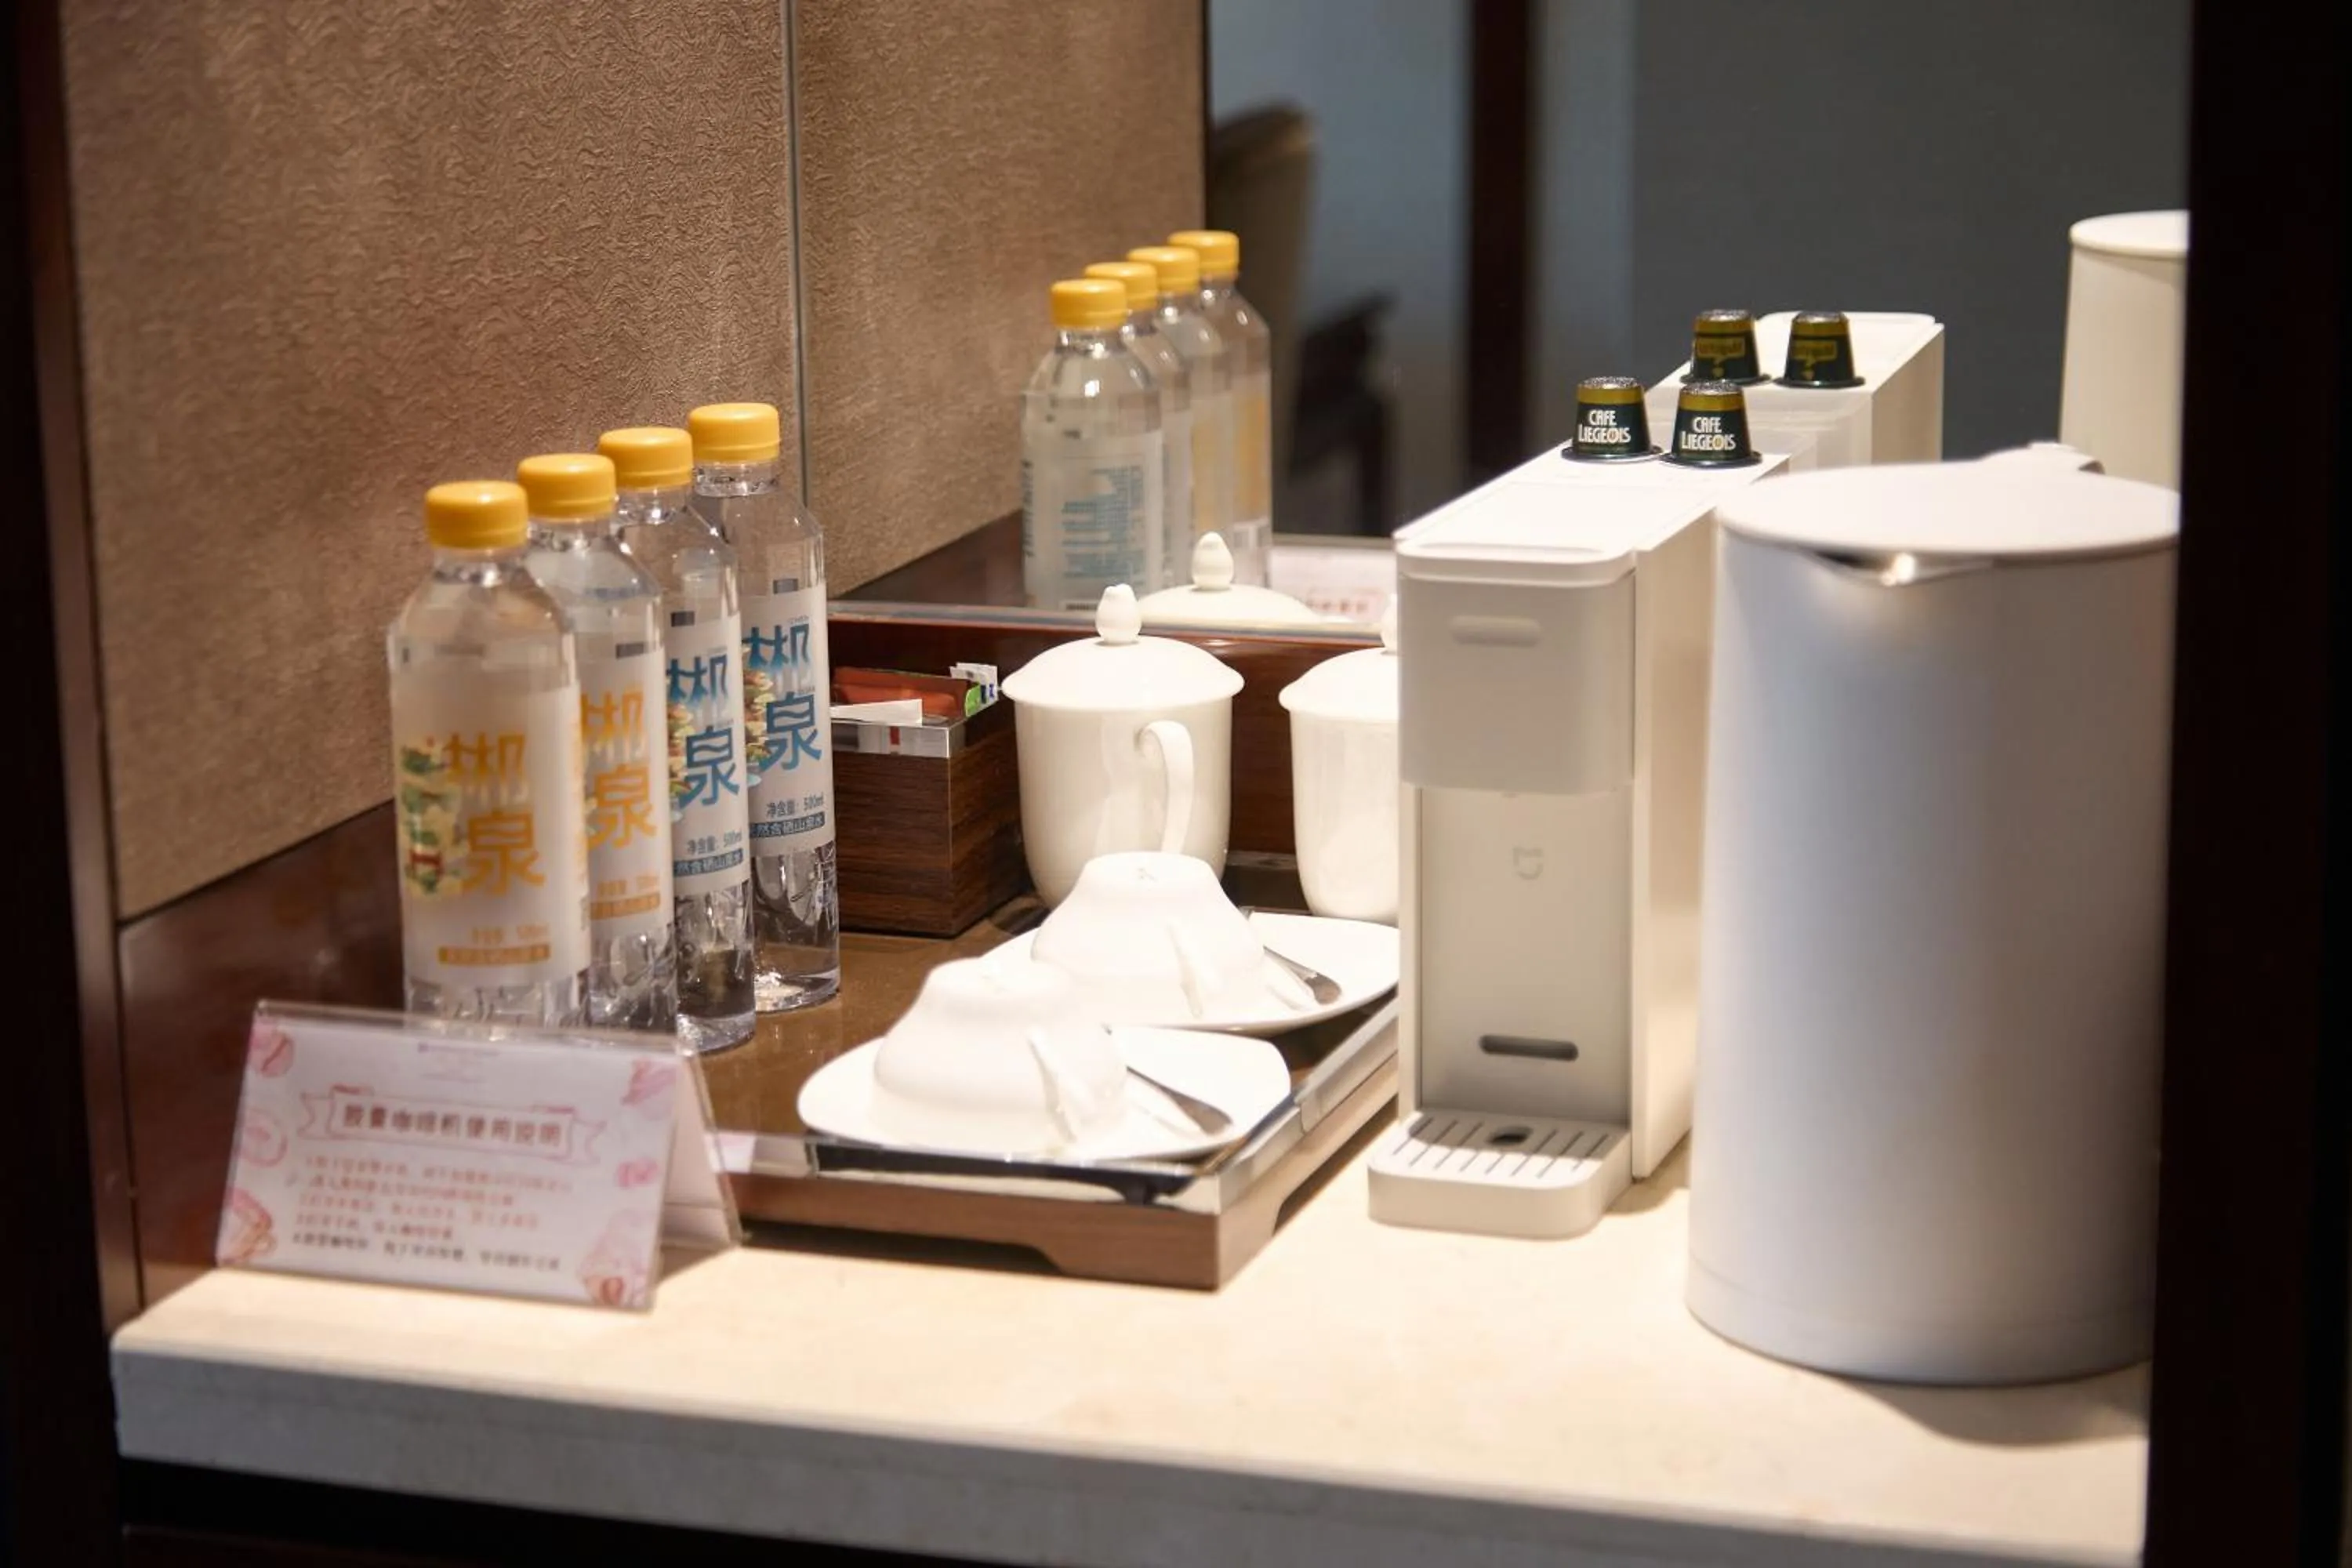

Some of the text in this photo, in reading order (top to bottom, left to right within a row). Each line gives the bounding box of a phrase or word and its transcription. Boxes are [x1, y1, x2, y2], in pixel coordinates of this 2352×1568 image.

[1588, 409, 1617, 426] CAFE
[1692, 416, 1722, 433] CAFE
[1577, 424, 1632, 444] LIEGEOIS
[1681, 431, 1737, 452] LIEGEOIS
